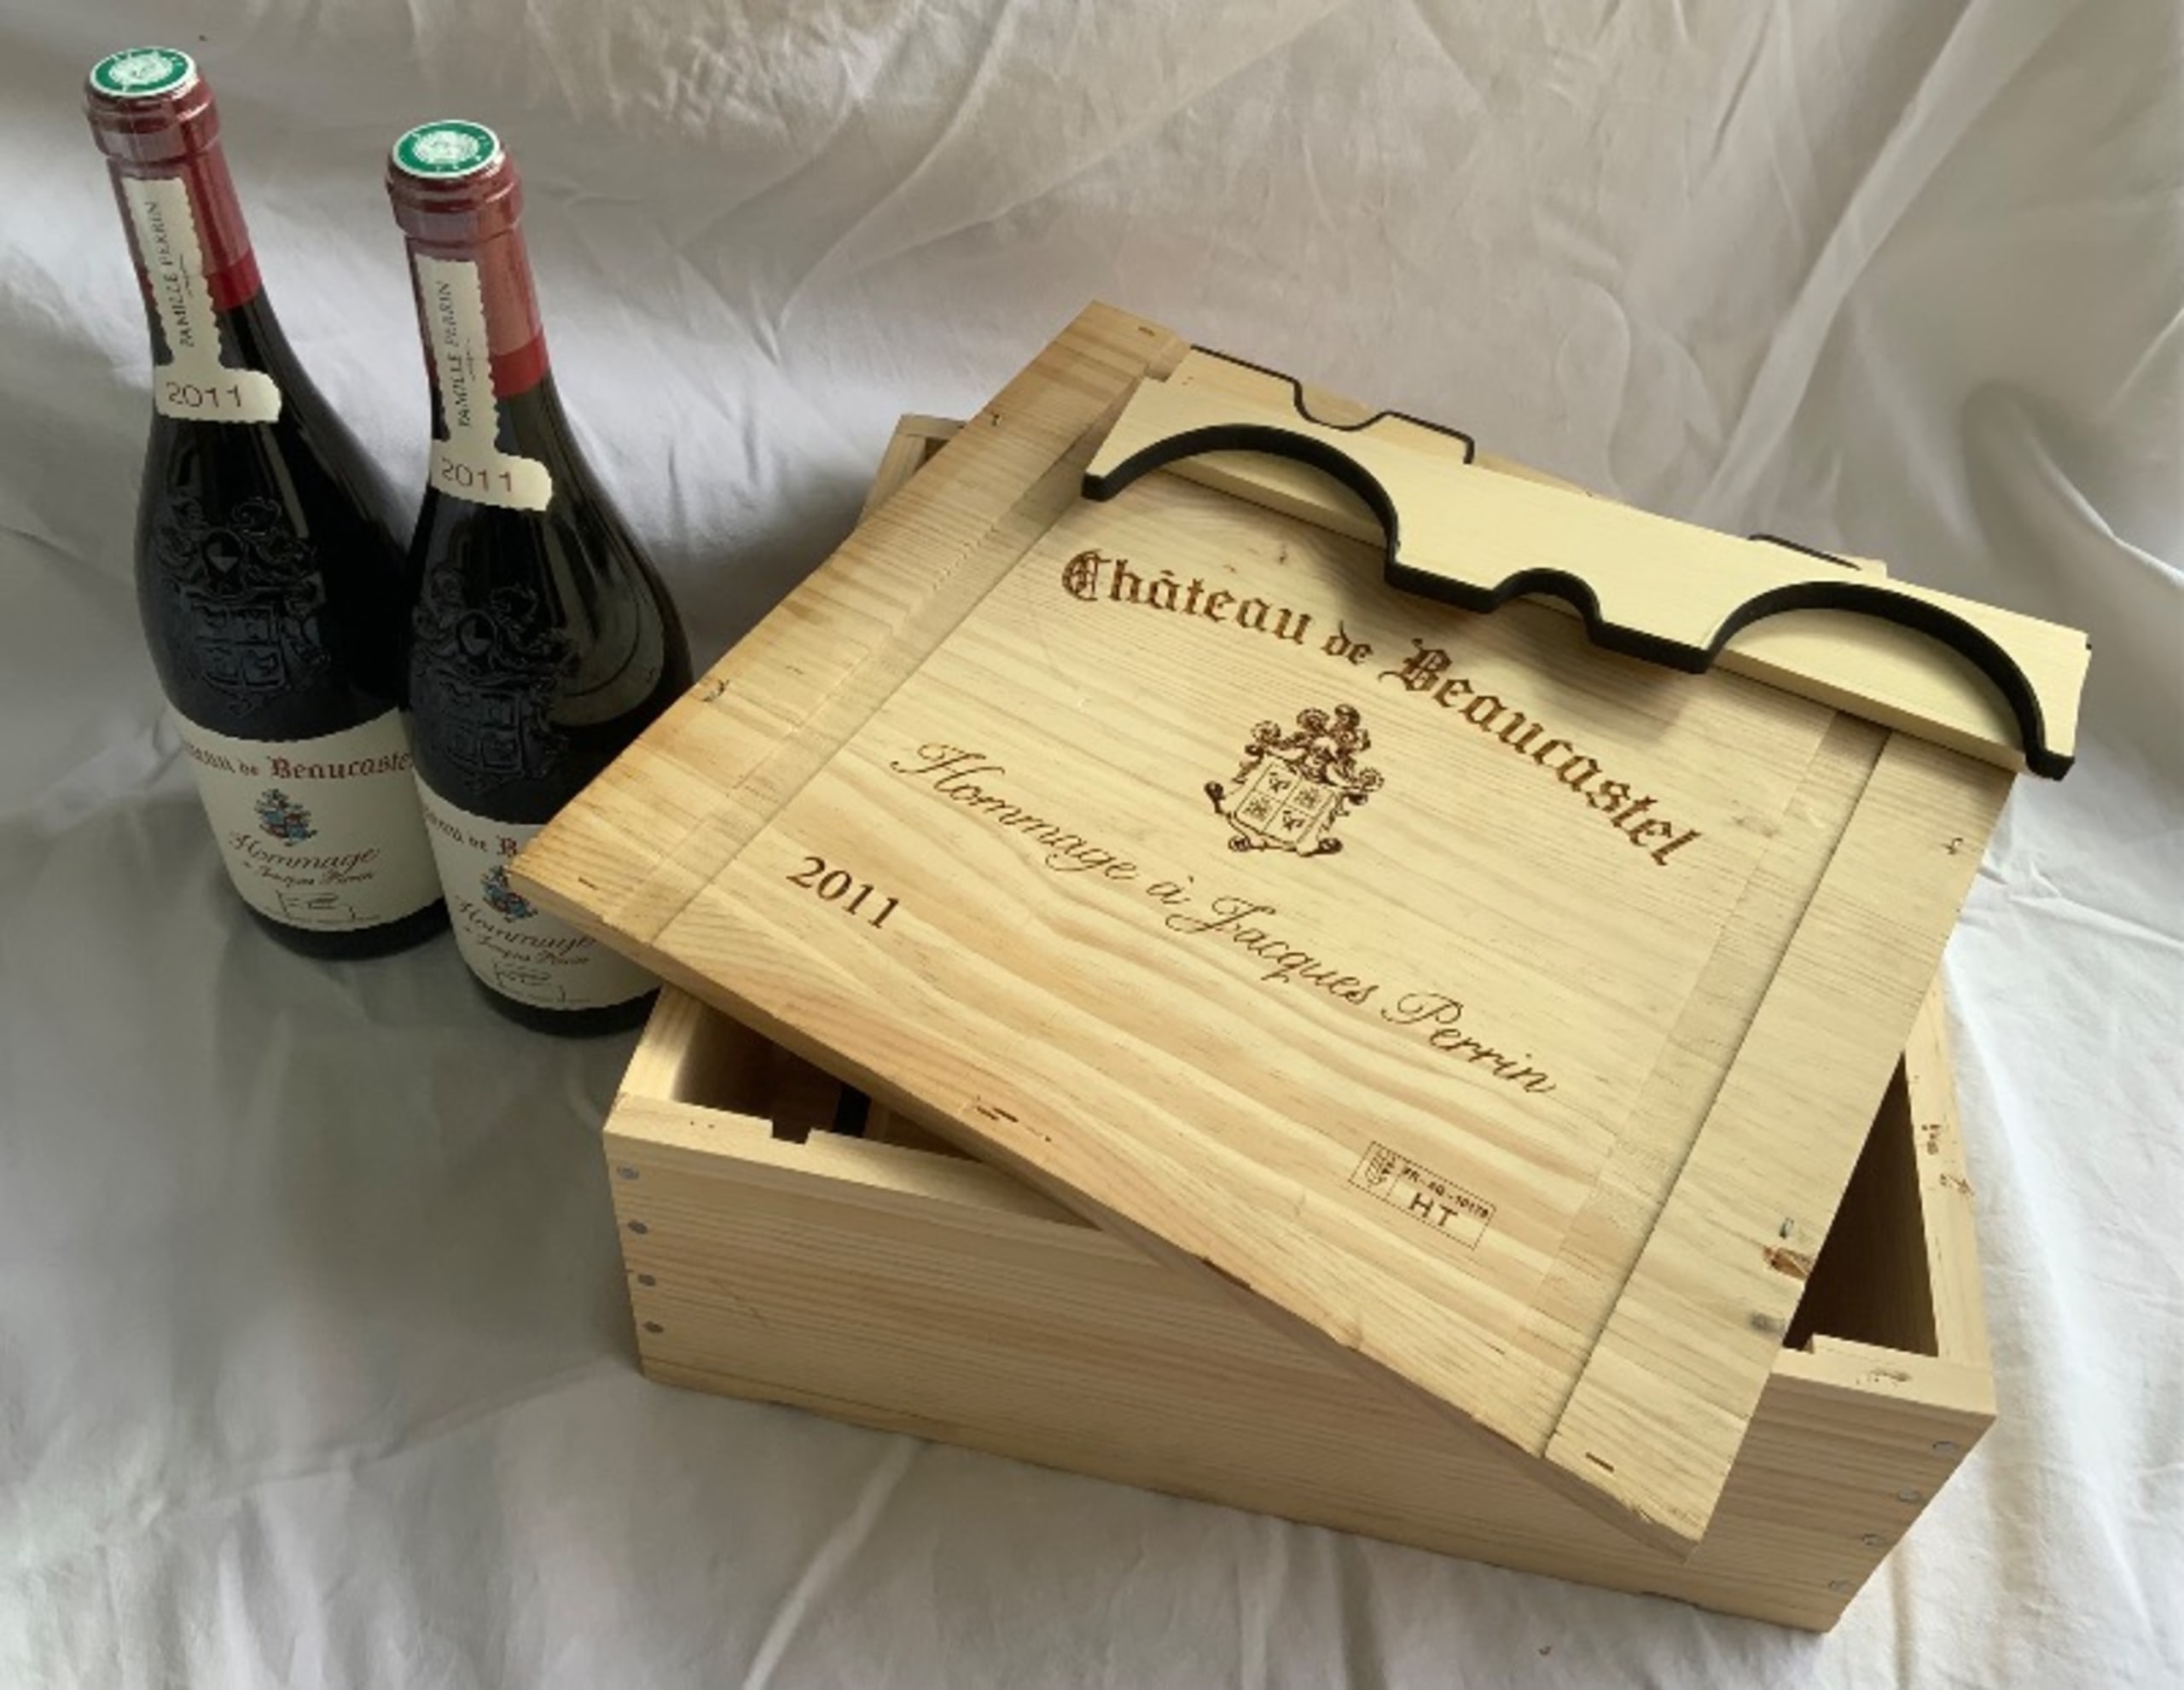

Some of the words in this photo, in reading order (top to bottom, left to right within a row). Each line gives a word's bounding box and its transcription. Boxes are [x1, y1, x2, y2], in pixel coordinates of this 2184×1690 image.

[166, 381, 241, 409] 2011
[441, 456, 513, 492] 2011
[1060, 548, 1313, 646] Château
[1320, 619, 1374, 665] de
[1378, 637, 1703, 867] Beaucastel
[266, 749, 412, 780] Beaucaste
[889, 740, 1140, 880] Hommage
[786, 854, 901, 930] 2011
[1146, 875, 1195, 906] à
[1164, 893, 1380, 1007] Jacques
[1380, 991, 1557, 1095] Perrin
